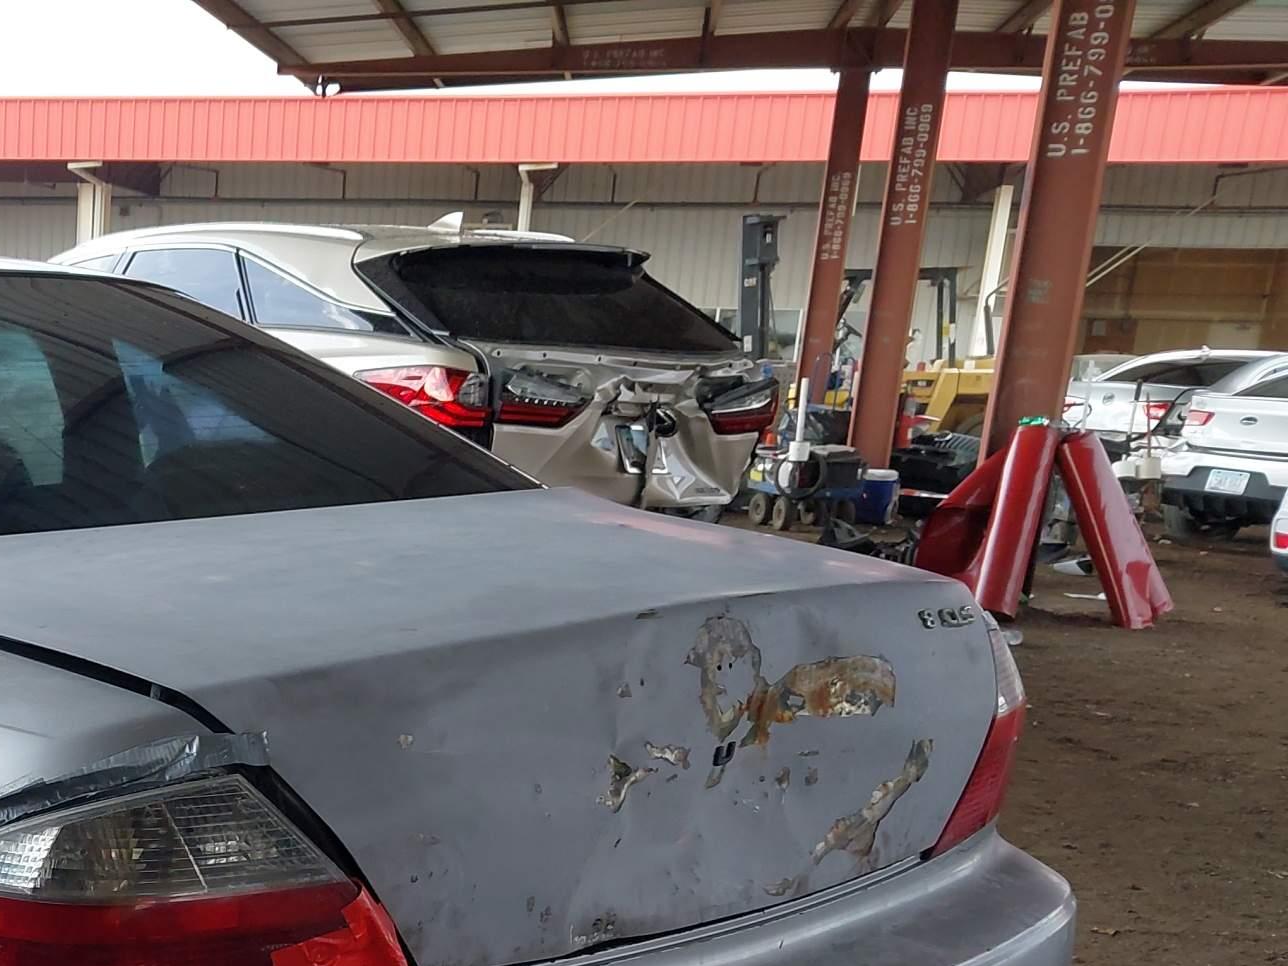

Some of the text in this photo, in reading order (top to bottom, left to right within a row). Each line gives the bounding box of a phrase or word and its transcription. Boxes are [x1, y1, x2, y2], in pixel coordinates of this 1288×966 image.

[1047, 11, 1089, 158] U.S. PREFAB
[1070, 0, 1116, 156] 1-866-799-0
[890, 199, 905, 226] U.S.
[895, 137, 914, 191] PREFAB
